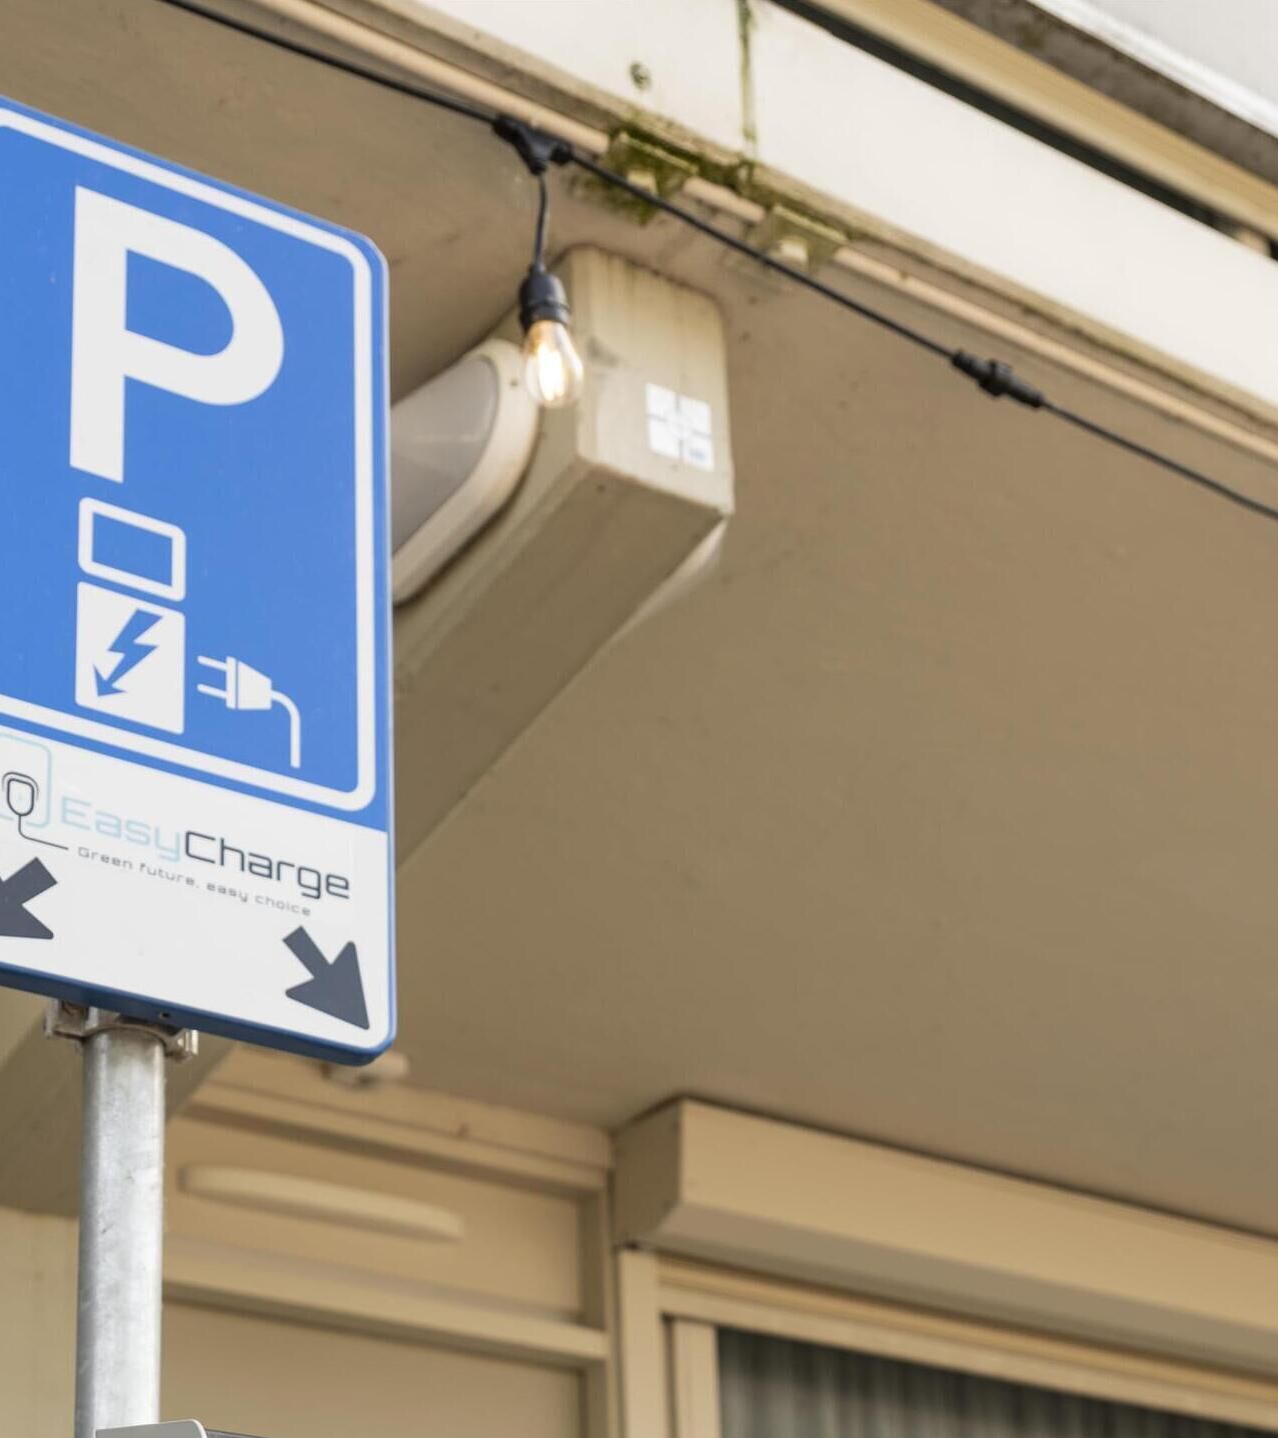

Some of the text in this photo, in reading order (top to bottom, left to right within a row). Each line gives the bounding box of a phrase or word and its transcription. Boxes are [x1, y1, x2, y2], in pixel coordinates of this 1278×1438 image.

[70, 184, 284, 483] P
[61, 796, 350, 900] EasyCharge
[77, 846, 133, 870] Green
[206, 882, 248, 902] easy
[255, 894, 311, 917] choice
